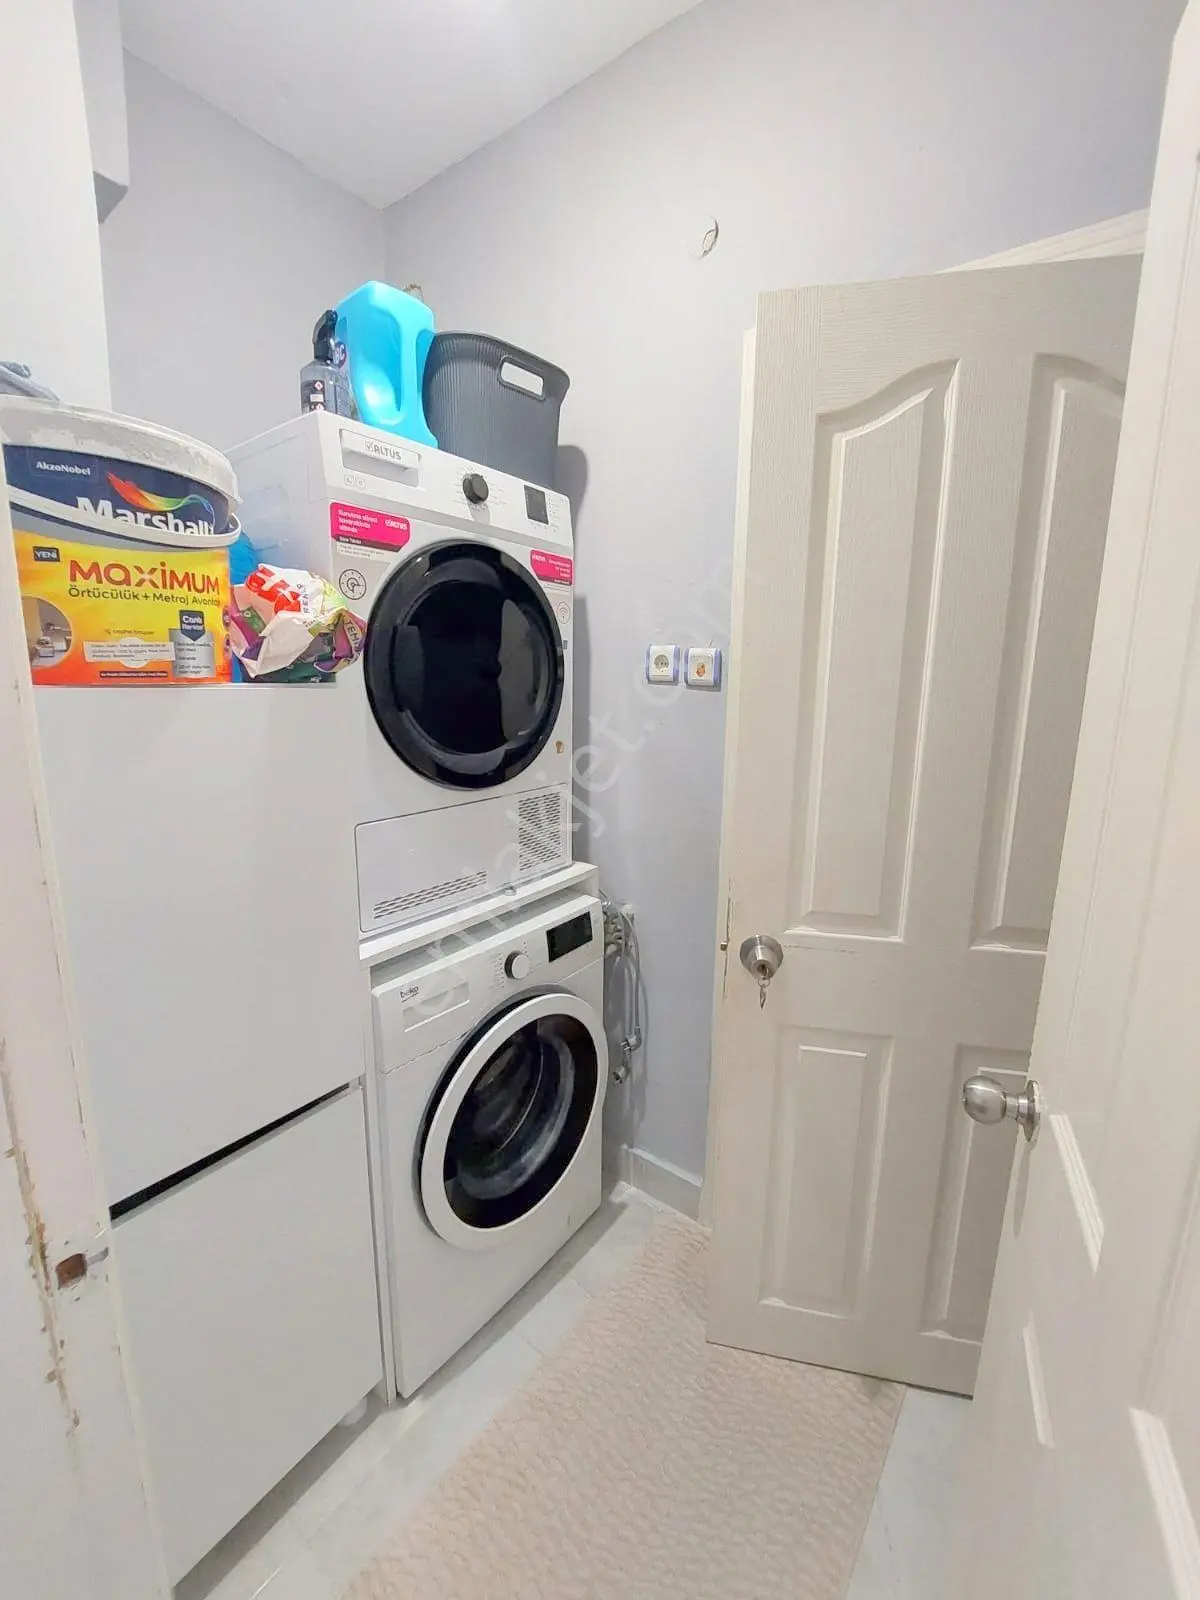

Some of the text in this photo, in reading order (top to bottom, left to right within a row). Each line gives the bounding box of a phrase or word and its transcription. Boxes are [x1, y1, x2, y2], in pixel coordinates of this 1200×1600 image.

[374, 443, 402, 461] ALTUS
[36, 461, 91, 476] AkzoNobel
[68, 585, 140, 601] Örtücülük
[152, 592, 189, 605] Metraj
[399, 984, 420, 999] beko
